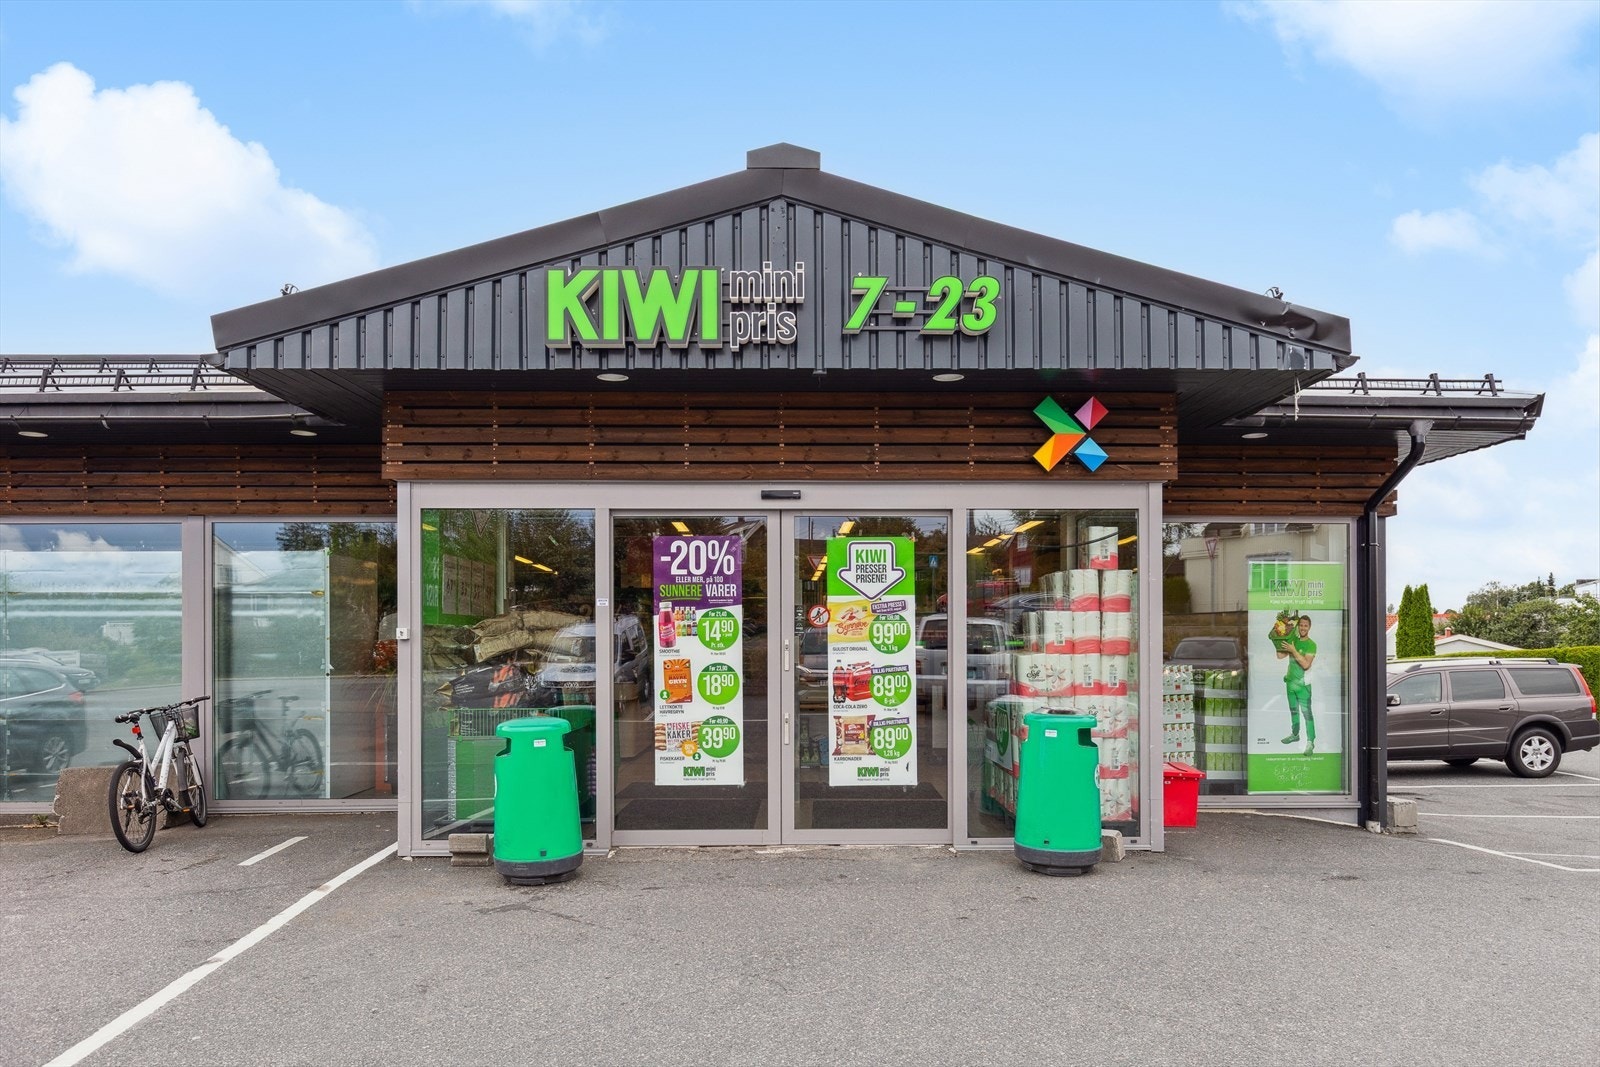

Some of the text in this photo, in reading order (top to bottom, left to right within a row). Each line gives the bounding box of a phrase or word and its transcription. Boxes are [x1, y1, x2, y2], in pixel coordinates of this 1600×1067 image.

[545, 261, 805, 348] KIWI mini
[842, 274, 889, 334] 7
[919, 274, 1001, 335] 23
[729, 302, 798, 352] pris
[660, 540, 735, 576] -20%
[855, 549, 887, 564] KIWI
[855, 563, 887, 574] PRESSER
[855, 573, 888, 584] PRISENE!
[660, 584, 737, 597] SUNNERE VARER
[1307, 590, 1323, 598] pris
[672, 722, 690, 730] FISKE
[667, 730, 691, 739] KAKER
[683, 766, 705, 777] KIWI
[857, 767, 879, 777] KIWI
